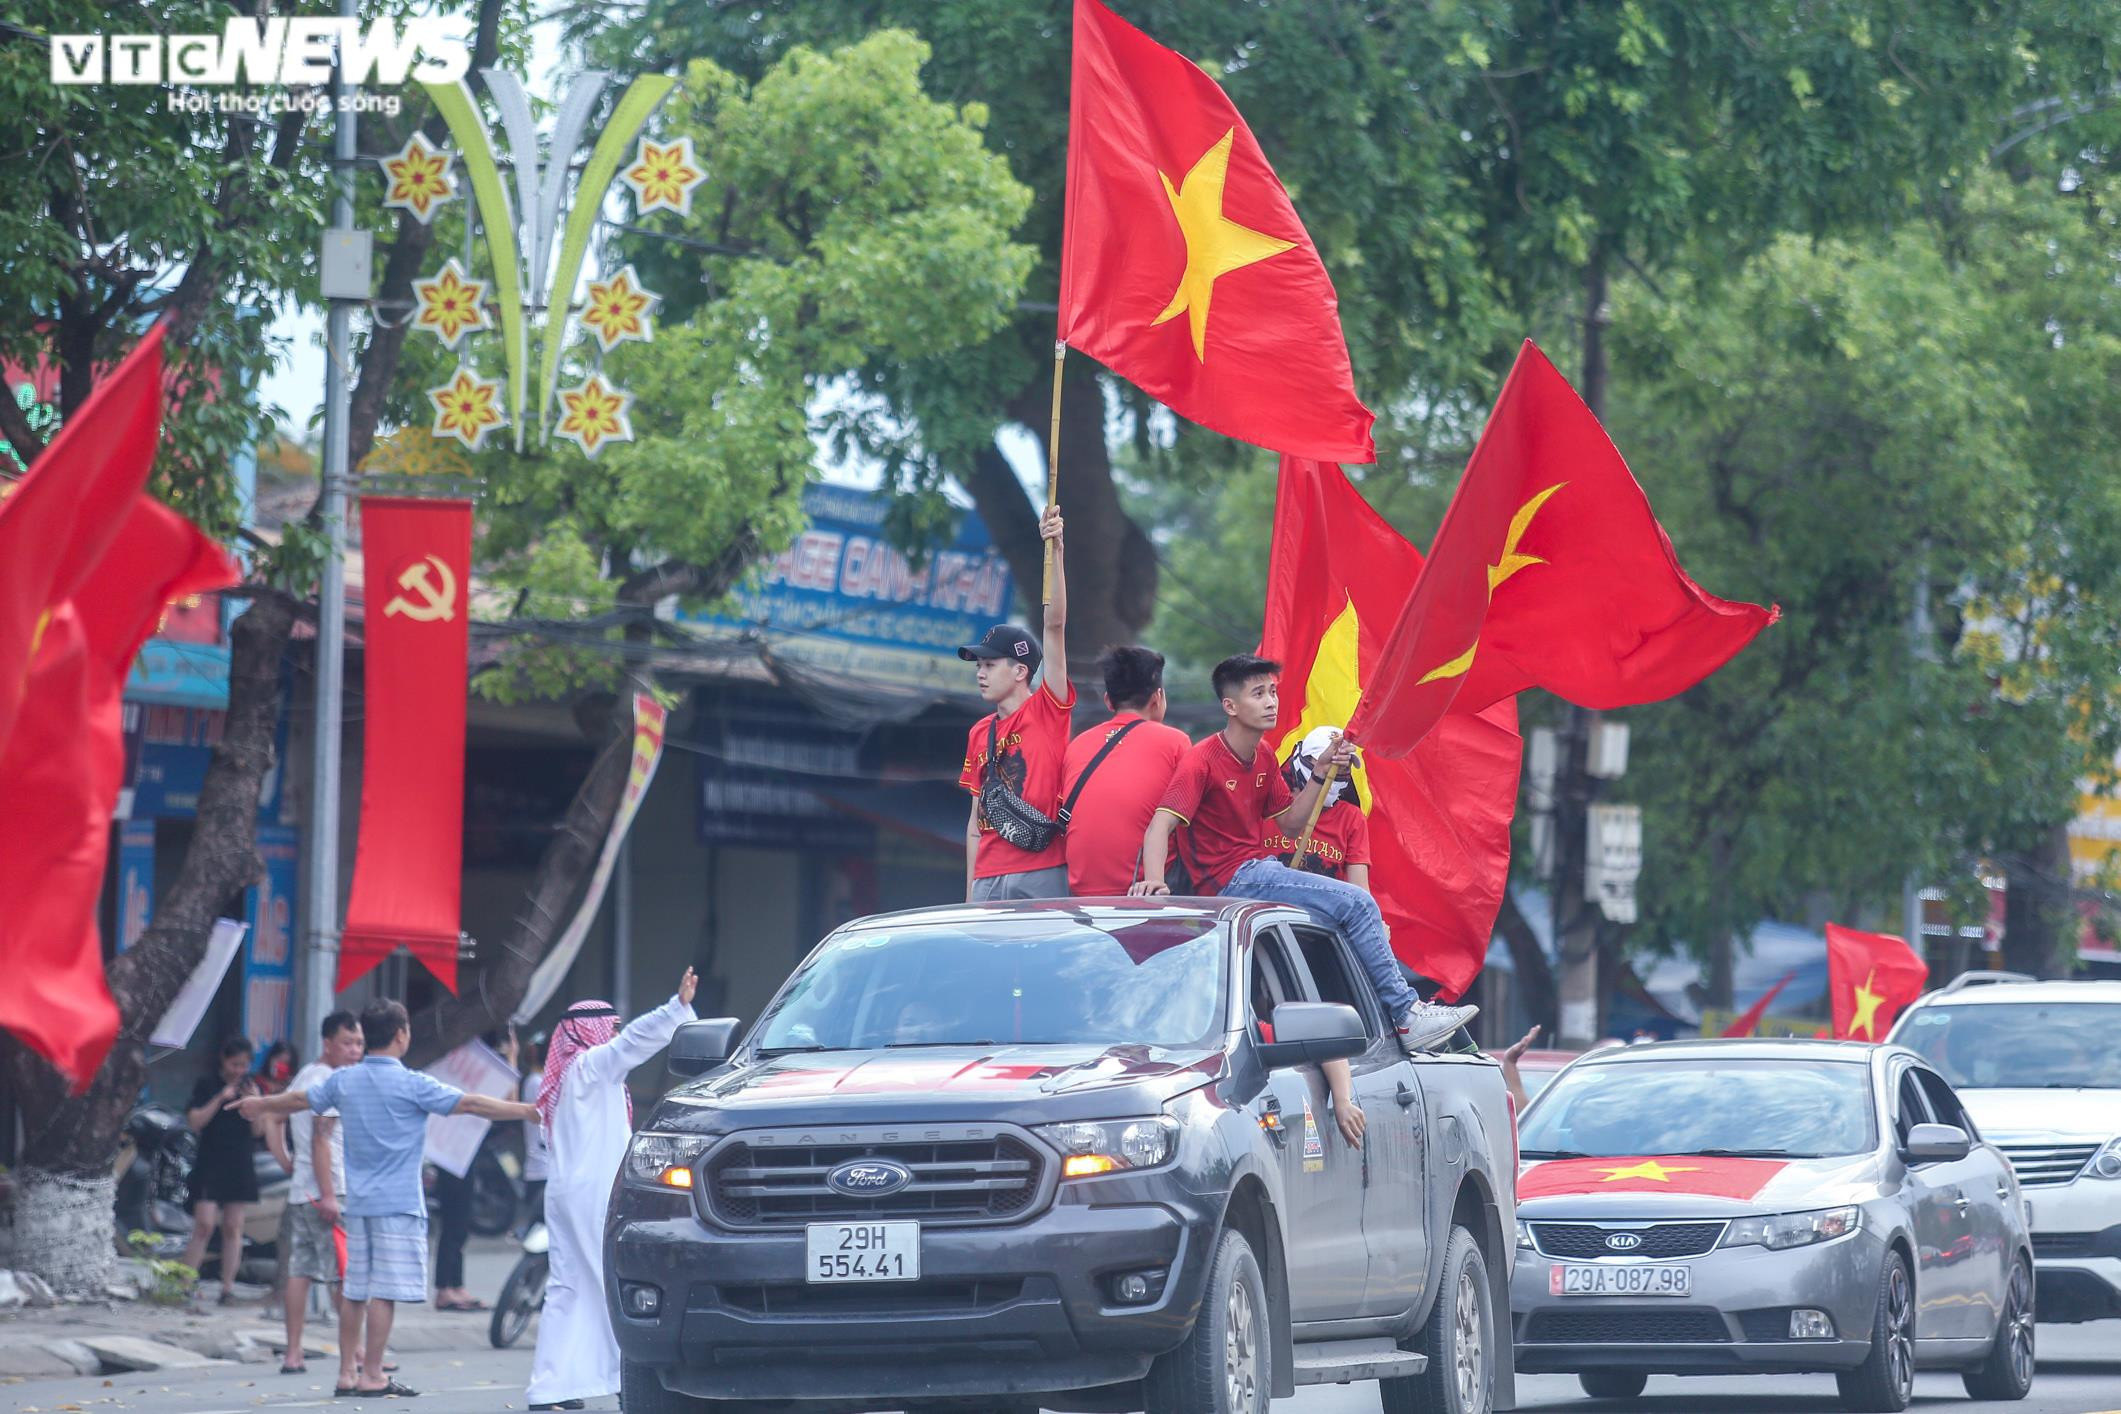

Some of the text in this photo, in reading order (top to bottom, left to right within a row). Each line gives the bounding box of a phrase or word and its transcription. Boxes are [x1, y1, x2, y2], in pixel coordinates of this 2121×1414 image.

[758, 1128, 983, 1145] RANGER
[846, 1168, 888, 1187] Ford
[838, 1226, 886, 1251] 29H
[1611, 1236, 1635, 1246] KIA
[819, 1253, 904, 1279] 554.41
[1567, 1268, 1687, 1291] 29A-087.98
